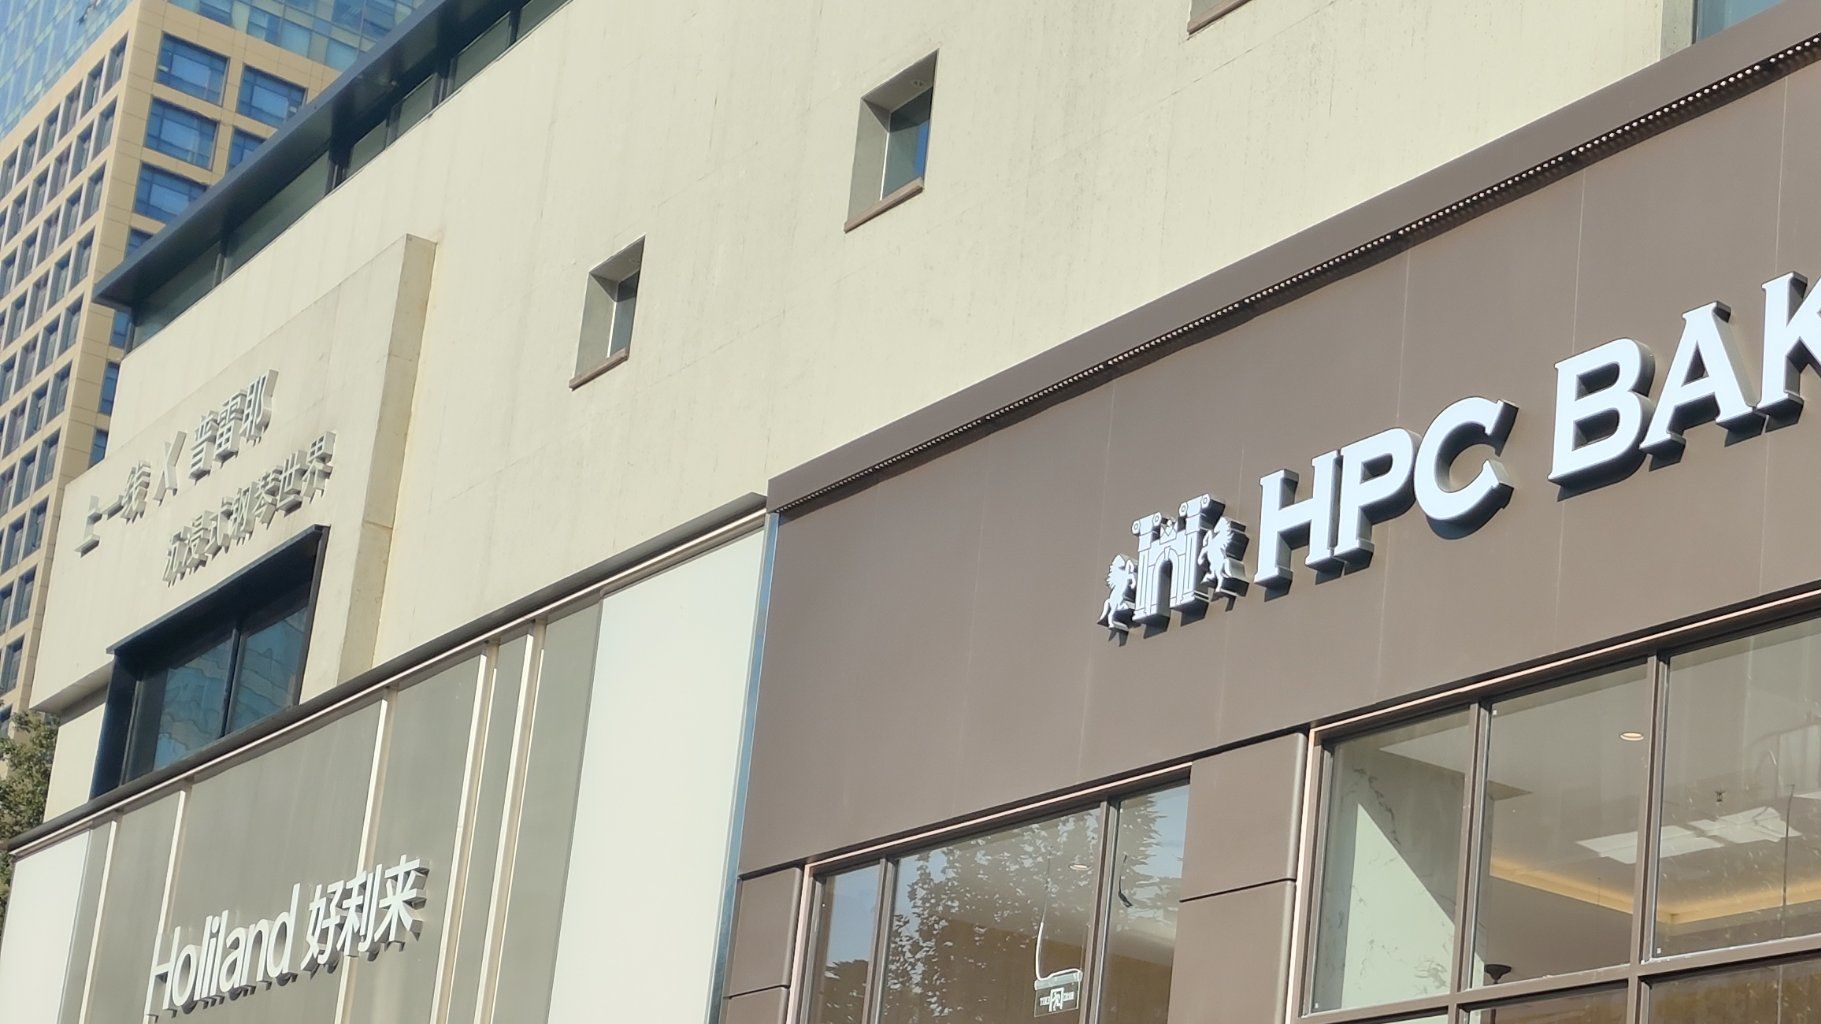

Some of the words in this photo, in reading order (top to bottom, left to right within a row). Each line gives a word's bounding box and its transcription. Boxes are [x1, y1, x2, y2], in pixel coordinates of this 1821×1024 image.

[163, 431, 336, 584] 沉浸式钢琴世界
[1254, 397, 1516, 594] HPC
[145, 883, 301, 1017] Holiland
[301, 854, 429, 970] 好利来
